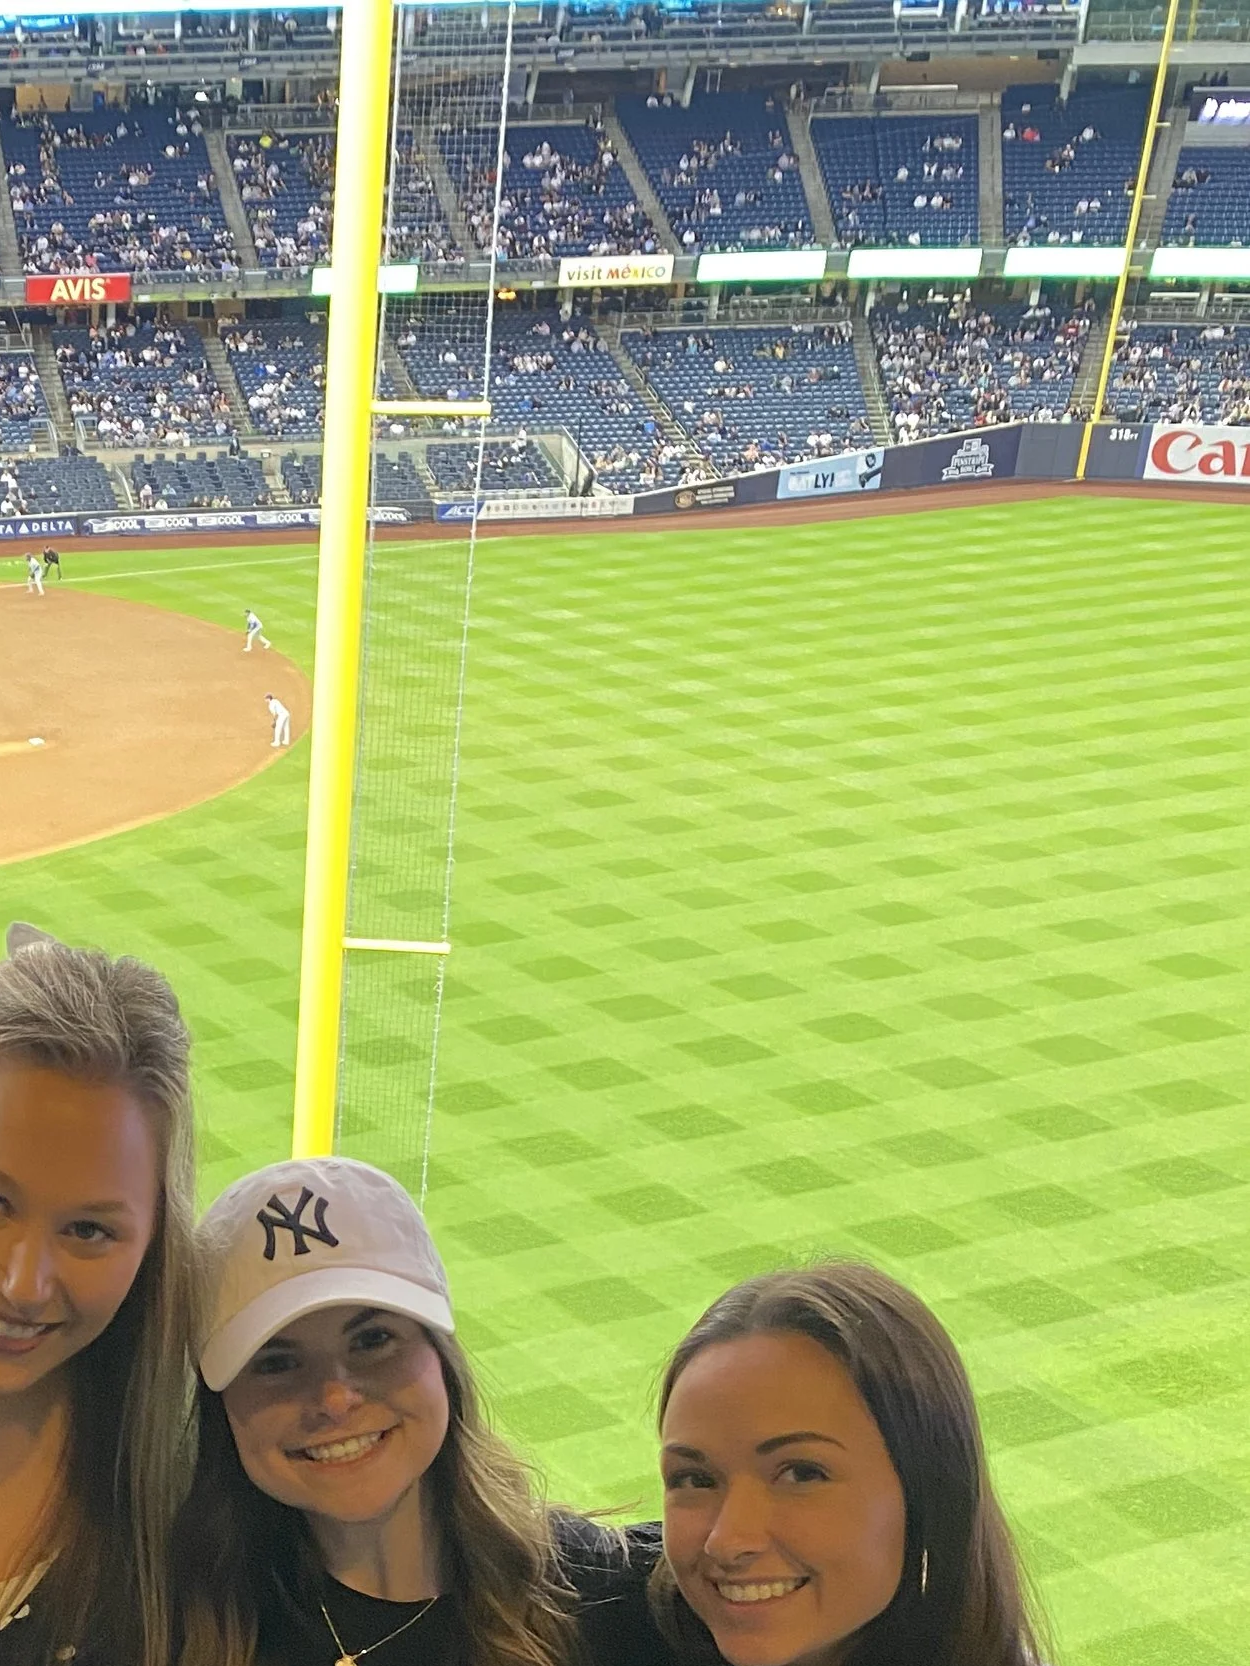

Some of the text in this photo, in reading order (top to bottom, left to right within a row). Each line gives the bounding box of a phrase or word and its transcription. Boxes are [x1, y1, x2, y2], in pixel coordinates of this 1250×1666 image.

[567, 265, 602, 281] visit
[50, 277, 106, 302] AVIS
[114, 518, 141, 530] COOL
[165, 516, 193, 528] COOL
[218, 515, 245, 525] COOL
[278, 512, 305, 524] COOL
[32, 520, 74, 532] DELTA
[256, 1186, 339, 1261] NY
